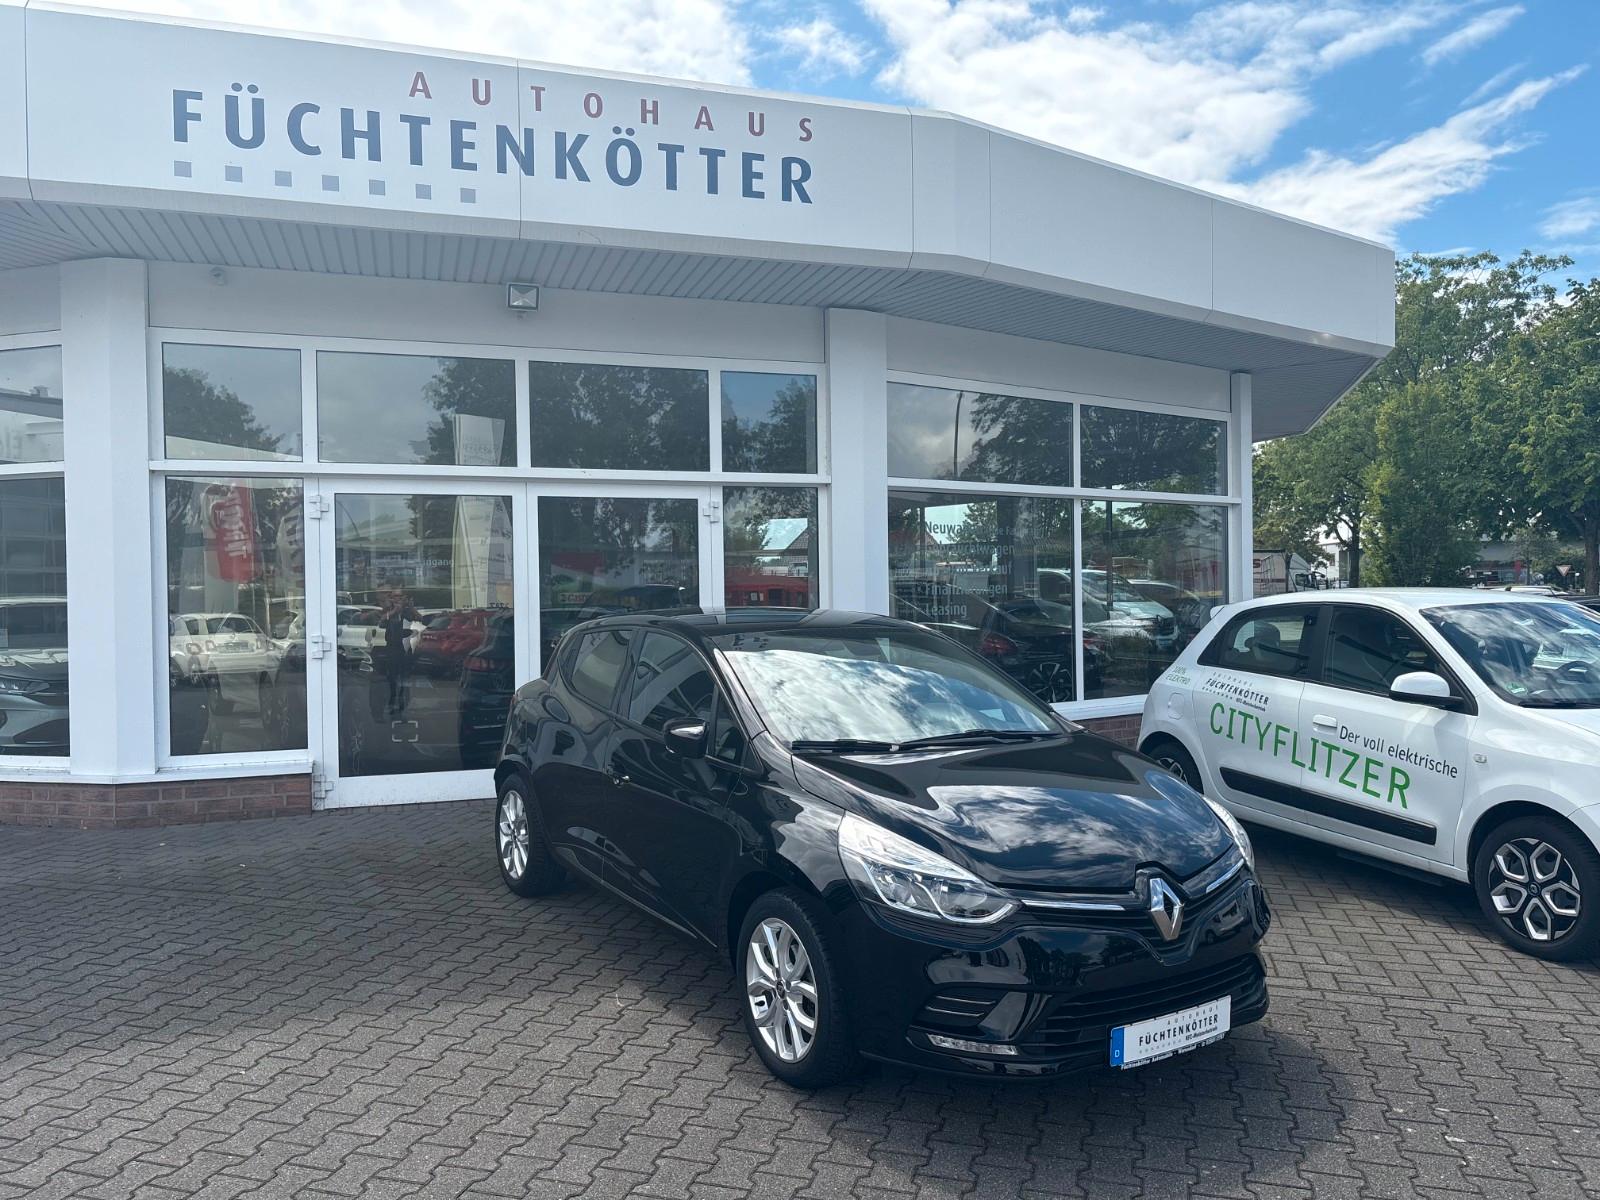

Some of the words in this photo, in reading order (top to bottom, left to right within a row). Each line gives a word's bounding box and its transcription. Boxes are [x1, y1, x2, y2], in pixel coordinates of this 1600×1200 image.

[408, 71, 813, 143] AUTOHAUS
[172, 82, 813, 204] FÜCHTENKÖTTER
[925, 521, 976, 537] Neuwa
[926, 540, 1014, 556] ebrauchtwagen
[925, 603, 967, 619] Leasing
[1165, 673, 1191, 685] ELEKTRO
[1205, 677, 1269, 705] FÜCHTENKÖTTER
[1209, 702, 1411, 809] CITYFLITZER
[1339, 725, 1361, 743] Der
[1363, 734, 1385, 754] voll
[1387, 744, 1458, 778] elektrische
[1139, 1013, 1219, 1046] FÜCHTENKÖTTER
